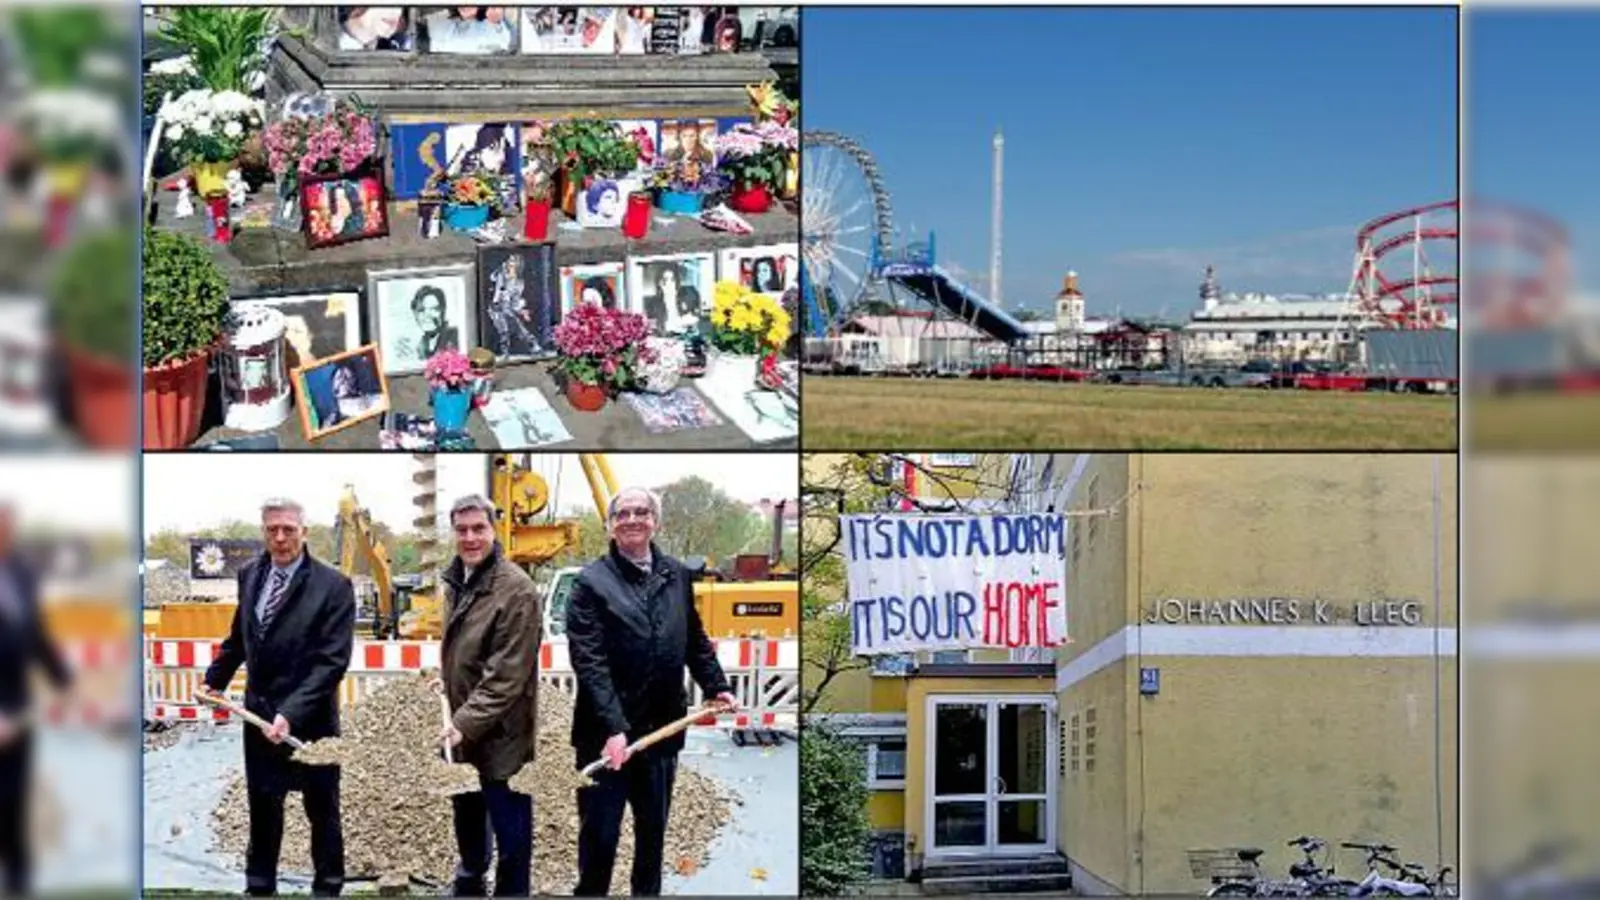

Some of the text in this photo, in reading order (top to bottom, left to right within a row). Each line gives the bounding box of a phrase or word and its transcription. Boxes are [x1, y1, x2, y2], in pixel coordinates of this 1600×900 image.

[899, 519, 964, 558] NOT
[966, 518, 990, 556] A
[853, 599, 876, 647] IT
[880, 596, 906, 641] IS
[909, 591, 976, 640] OUR
[1148, 599, 1300, 623] JOHANNES
